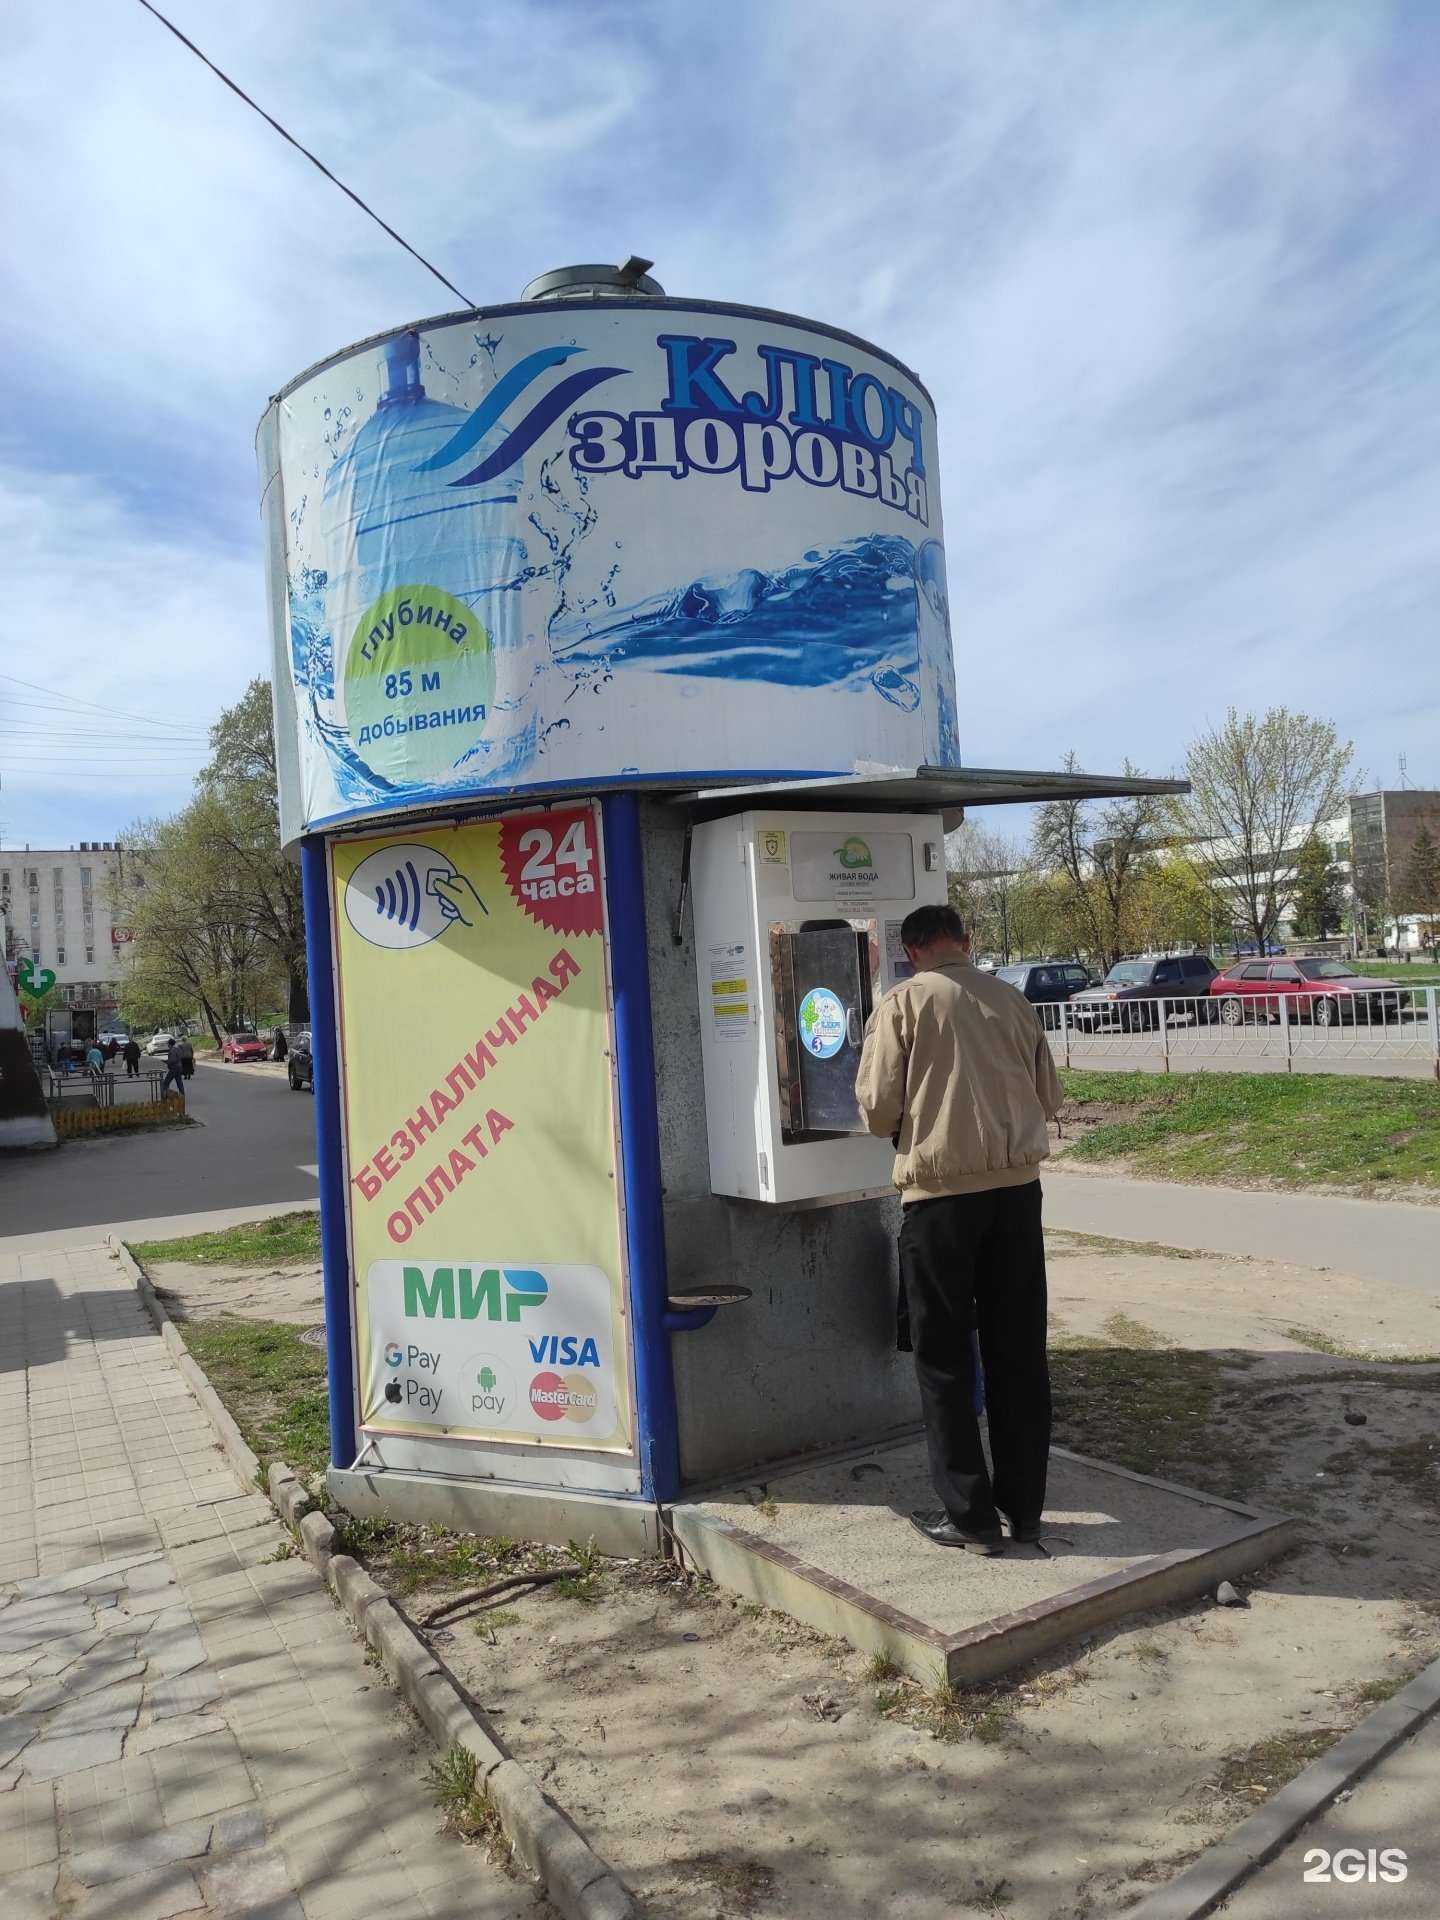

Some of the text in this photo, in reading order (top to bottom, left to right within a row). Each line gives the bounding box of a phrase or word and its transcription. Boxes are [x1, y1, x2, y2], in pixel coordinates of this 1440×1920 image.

[657, 334, 925, 475] КЛЮЧ
[361, 599, 468, 660] глубина
[385, 670, 441, 699] 85 м
[358, 704, 487, 747] добывания
[517, 821, 594, 880] 24
[520, 873, 596, 901] часа
[829, 872, 879, 881] ЖИВАЯ ВОДА
[353, 948, 583, 1202] БЕЗНАЛИЧНАЯ
[386, 1107, 515, 1245] ОПЛАТА
[403, 1266, 549, 1322] МИР
[407, 1345, 441, 1375] Pay
[528, 1335, 601, 1368] VISA
[406, 1379, 443, 1414] Pay
[471, 1394, 505, 1415] pay
[530, 1388, 598, 1409] MasterCard
